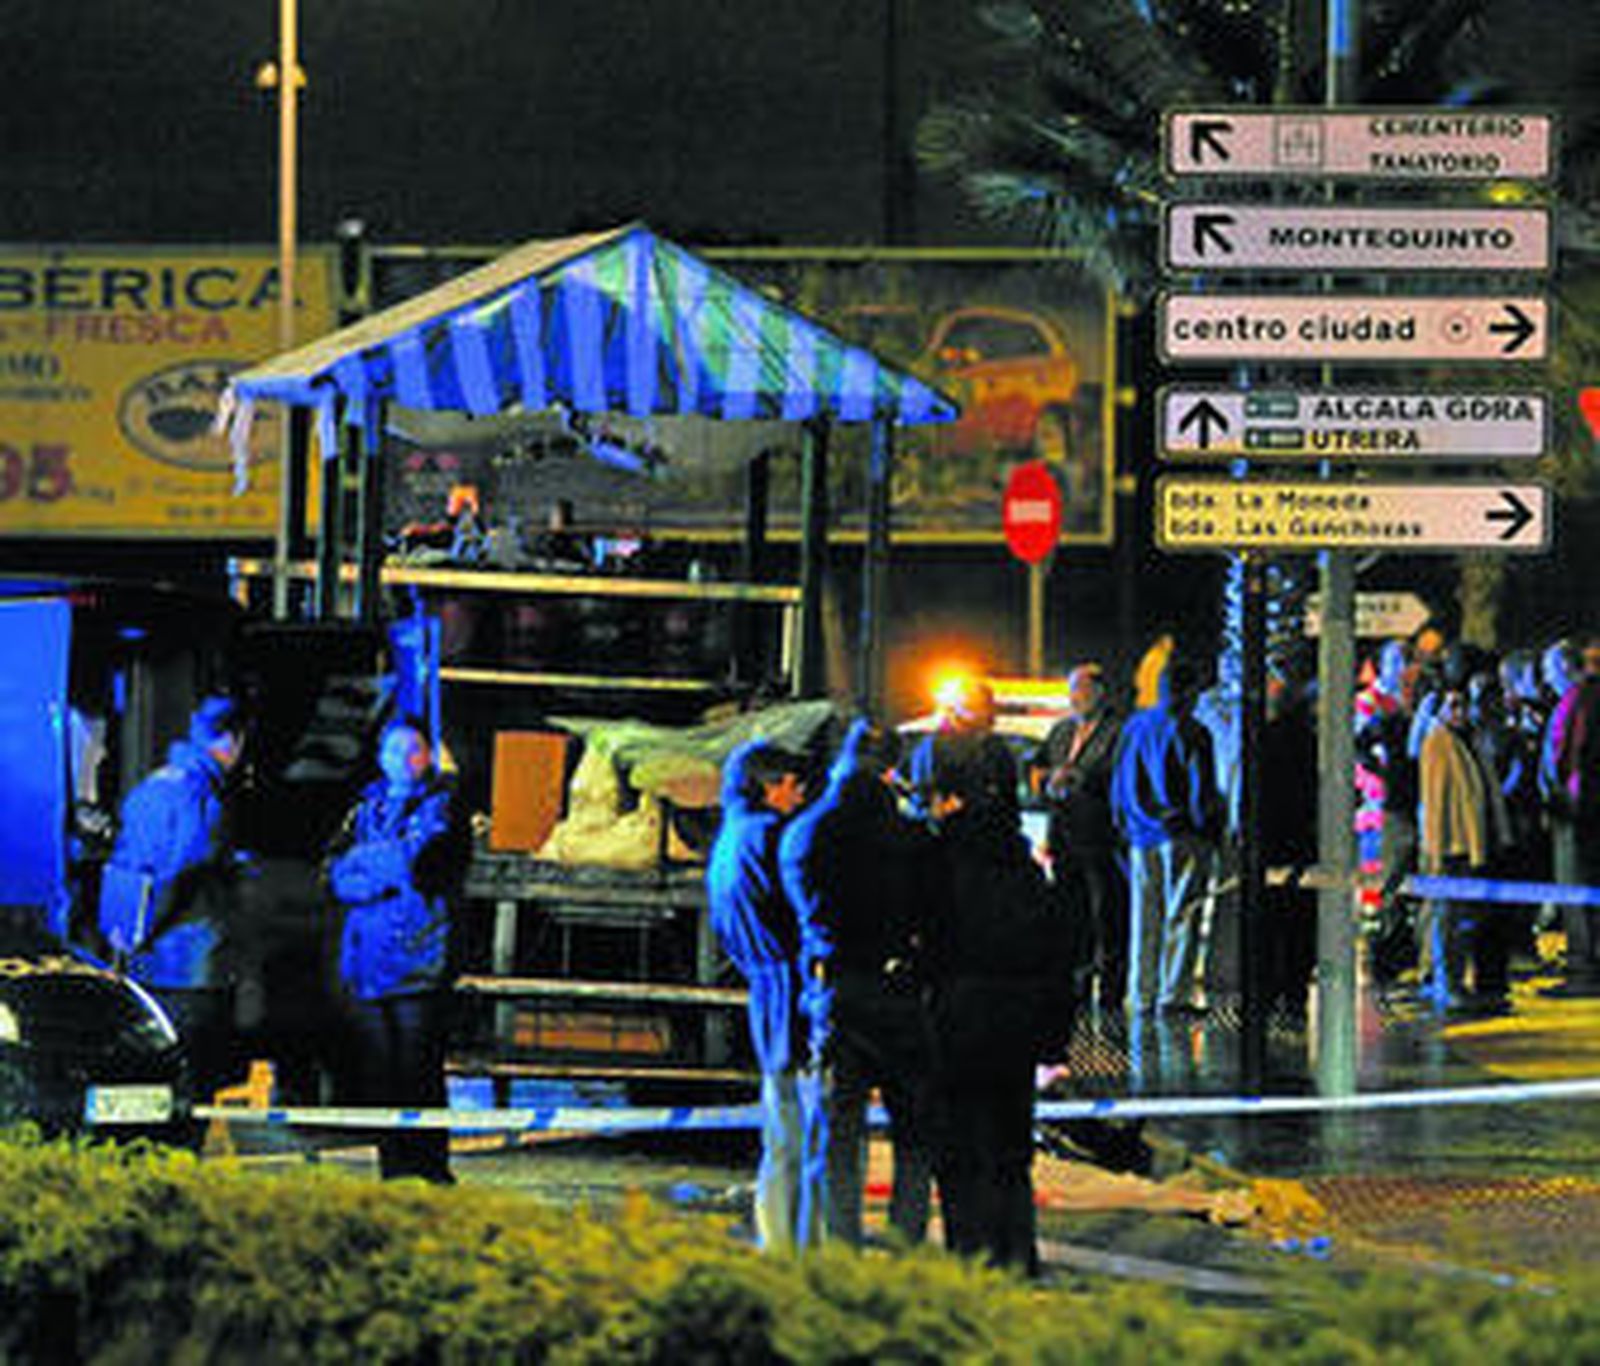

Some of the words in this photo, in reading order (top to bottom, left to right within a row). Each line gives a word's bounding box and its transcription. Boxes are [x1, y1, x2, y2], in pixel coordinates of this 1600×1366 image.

[1368, 117, 1525, 140] CEMENTERIO
[1368, 152, 1501, 174] TANATORIO
[1268, 226, 1515, 250] MONTEQUINTO
[1173, 315, 1287, 341] centro
[1299, 314, 1416, 341] ciudad
[1312, 399, 1435, 421] ALCALA
[1445, 399, 1535, 421] GDRA
[1311, 429, 1421, 450] UTRERA
